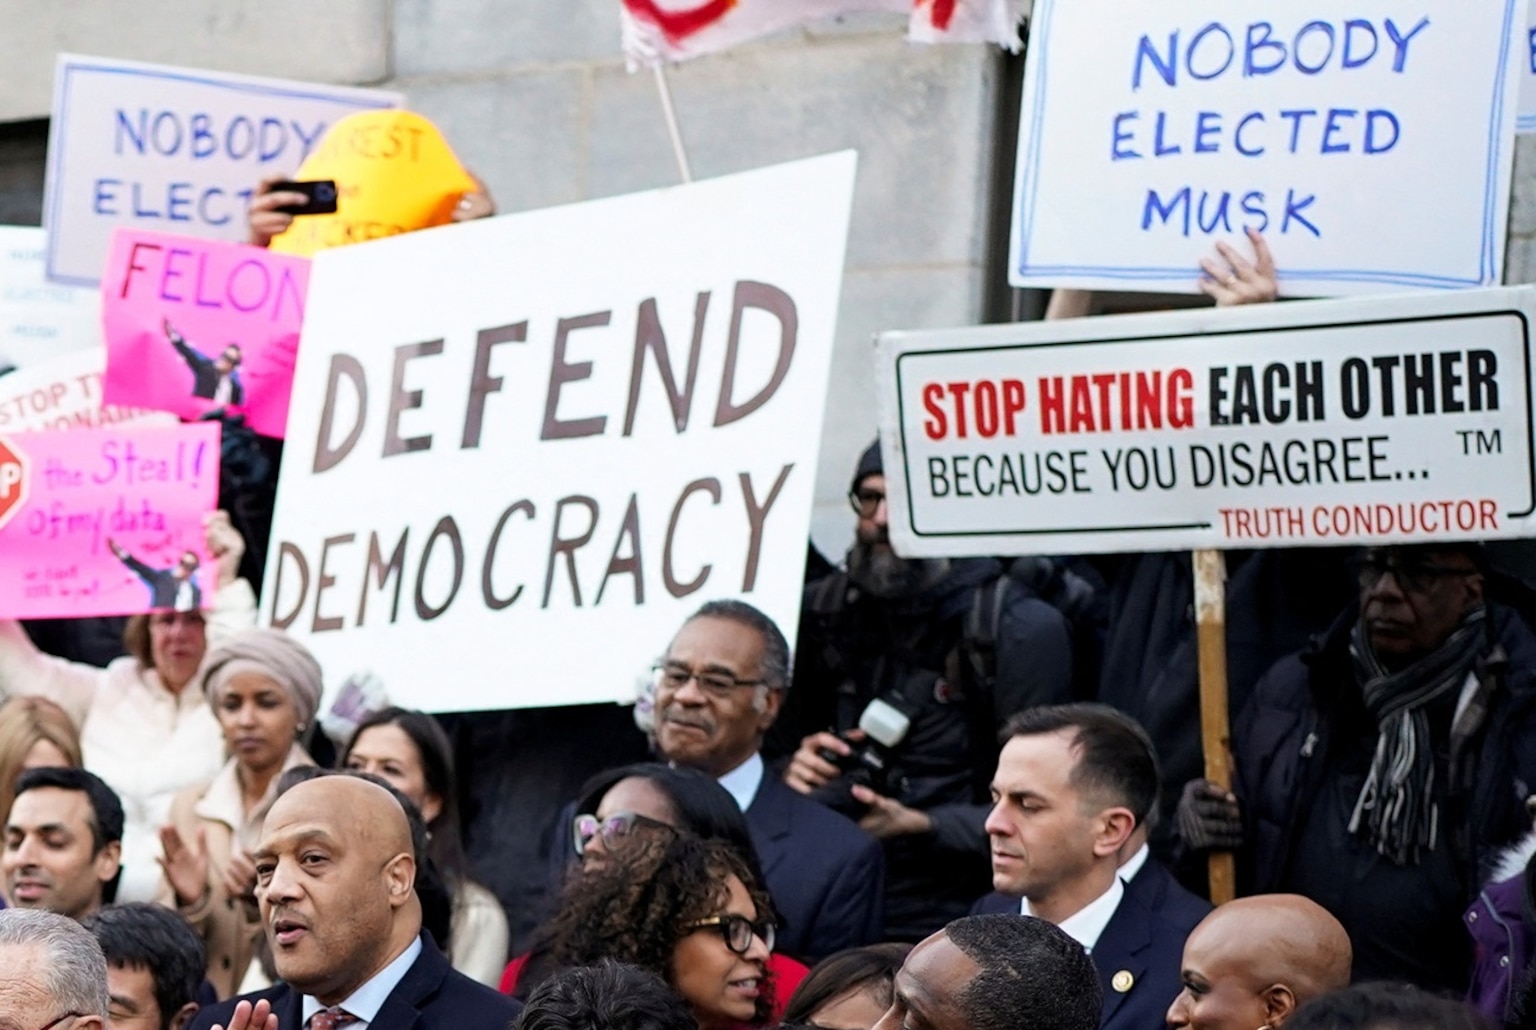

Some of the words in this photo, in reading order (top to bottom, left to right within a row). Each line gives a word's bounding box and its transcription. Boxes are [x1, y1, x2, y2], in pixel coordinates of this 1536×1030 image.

[1133, 18, 1430, 90] NOBODY
[114, 108, 328, 165] NOBODY
[1112, 107, 1401, 160] ELECTED
[94, 178, 253, 226] ELECT
[1142, 187, 1322, 238] MUSK
[311, 279, 799, 475] DEFEND
[923, 381, 1026, 440] STOP
[1038, 368, 1194, 434] HATING
[1209, 360, 1325, 426] EACH
[1340, 349, 1500, 420] OTHER
[92, 438, 208, 488] Steal!
[928, 451, 1091, 497] BECAUSE
[1102, 447, 1176, 490] YOU
[1189, 435, 1429, 488] DISAGREE...
[1456, 429, 1503, 455] TM
[111, 496, 167, 533] data
[1219, 507, 1305, 537] TRUTH
[1313, 500, 1498, 537] CONDUCTOR
[270, 463, 796, 633] DEMOCRACY
